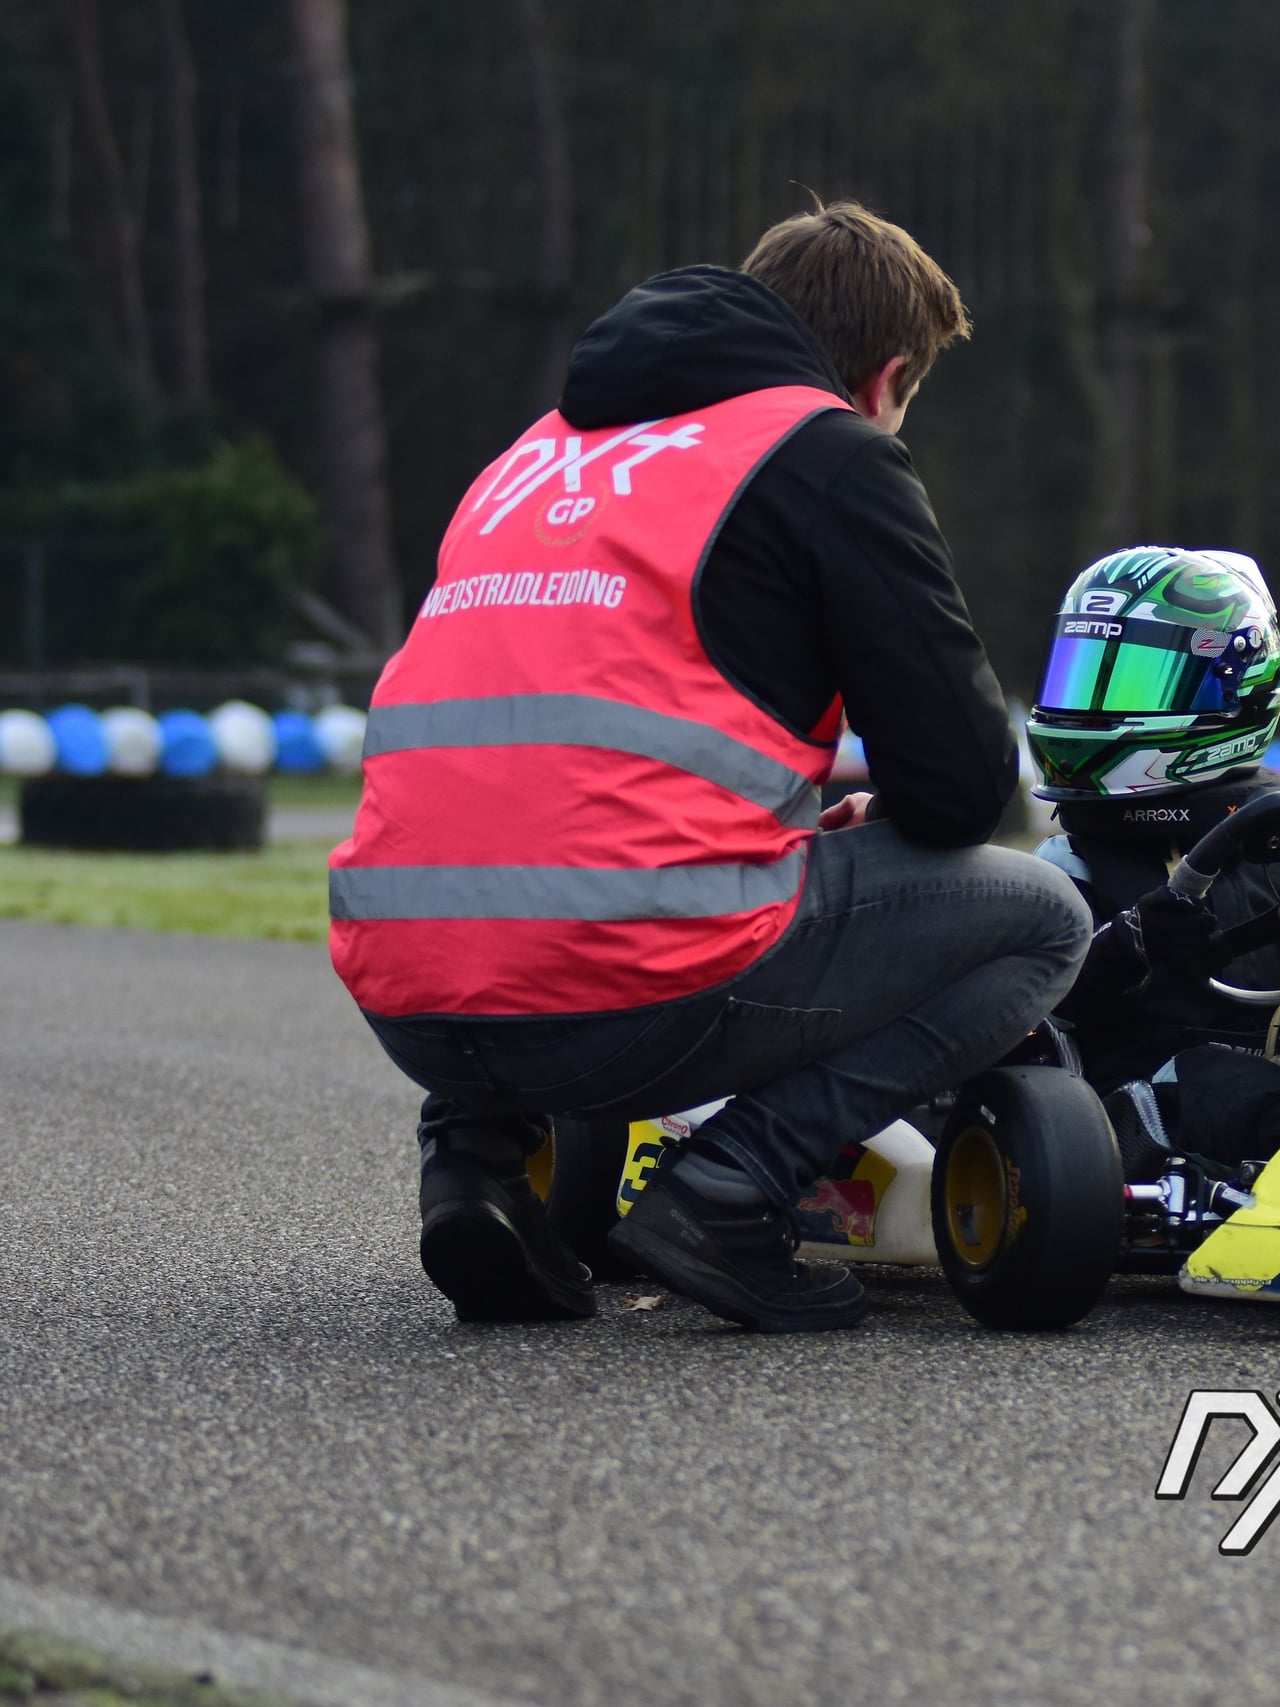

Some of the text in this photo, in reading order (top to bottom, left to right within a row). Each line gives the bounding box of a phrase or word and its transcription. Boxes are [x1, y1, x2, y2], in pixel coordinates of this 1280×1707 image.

[546, 496, 596, 525] GP
[421, 568, 627, 619] WEDSTRIJDLEIDING
[1064, 621, 1123, 639] zamp
